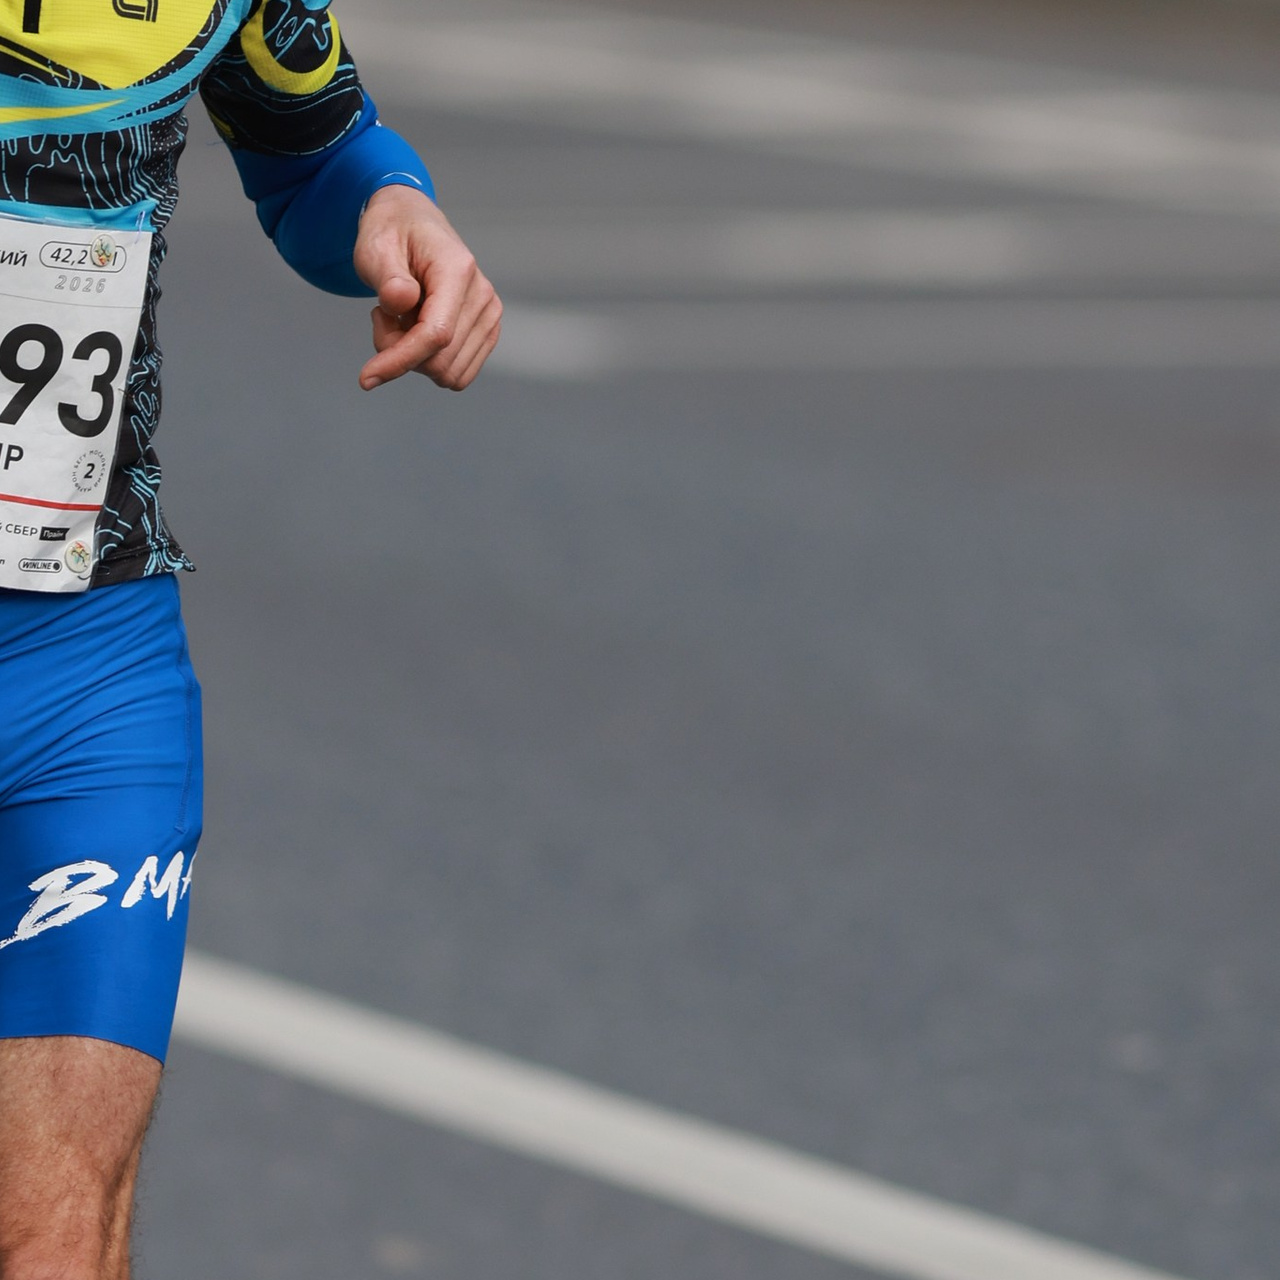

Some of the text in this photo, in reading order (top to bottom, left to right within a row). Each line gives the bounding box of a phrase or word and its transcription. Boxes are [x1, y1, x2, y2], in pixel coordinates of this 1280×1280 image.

[50, 247, 88, 267] 42,2
[54, 275, 107, 293] 2026
[83, 463, 96, 479] 2
[5, 523, 38, 537] СБЕР
[22, 561, 52, 571] WINLINE
